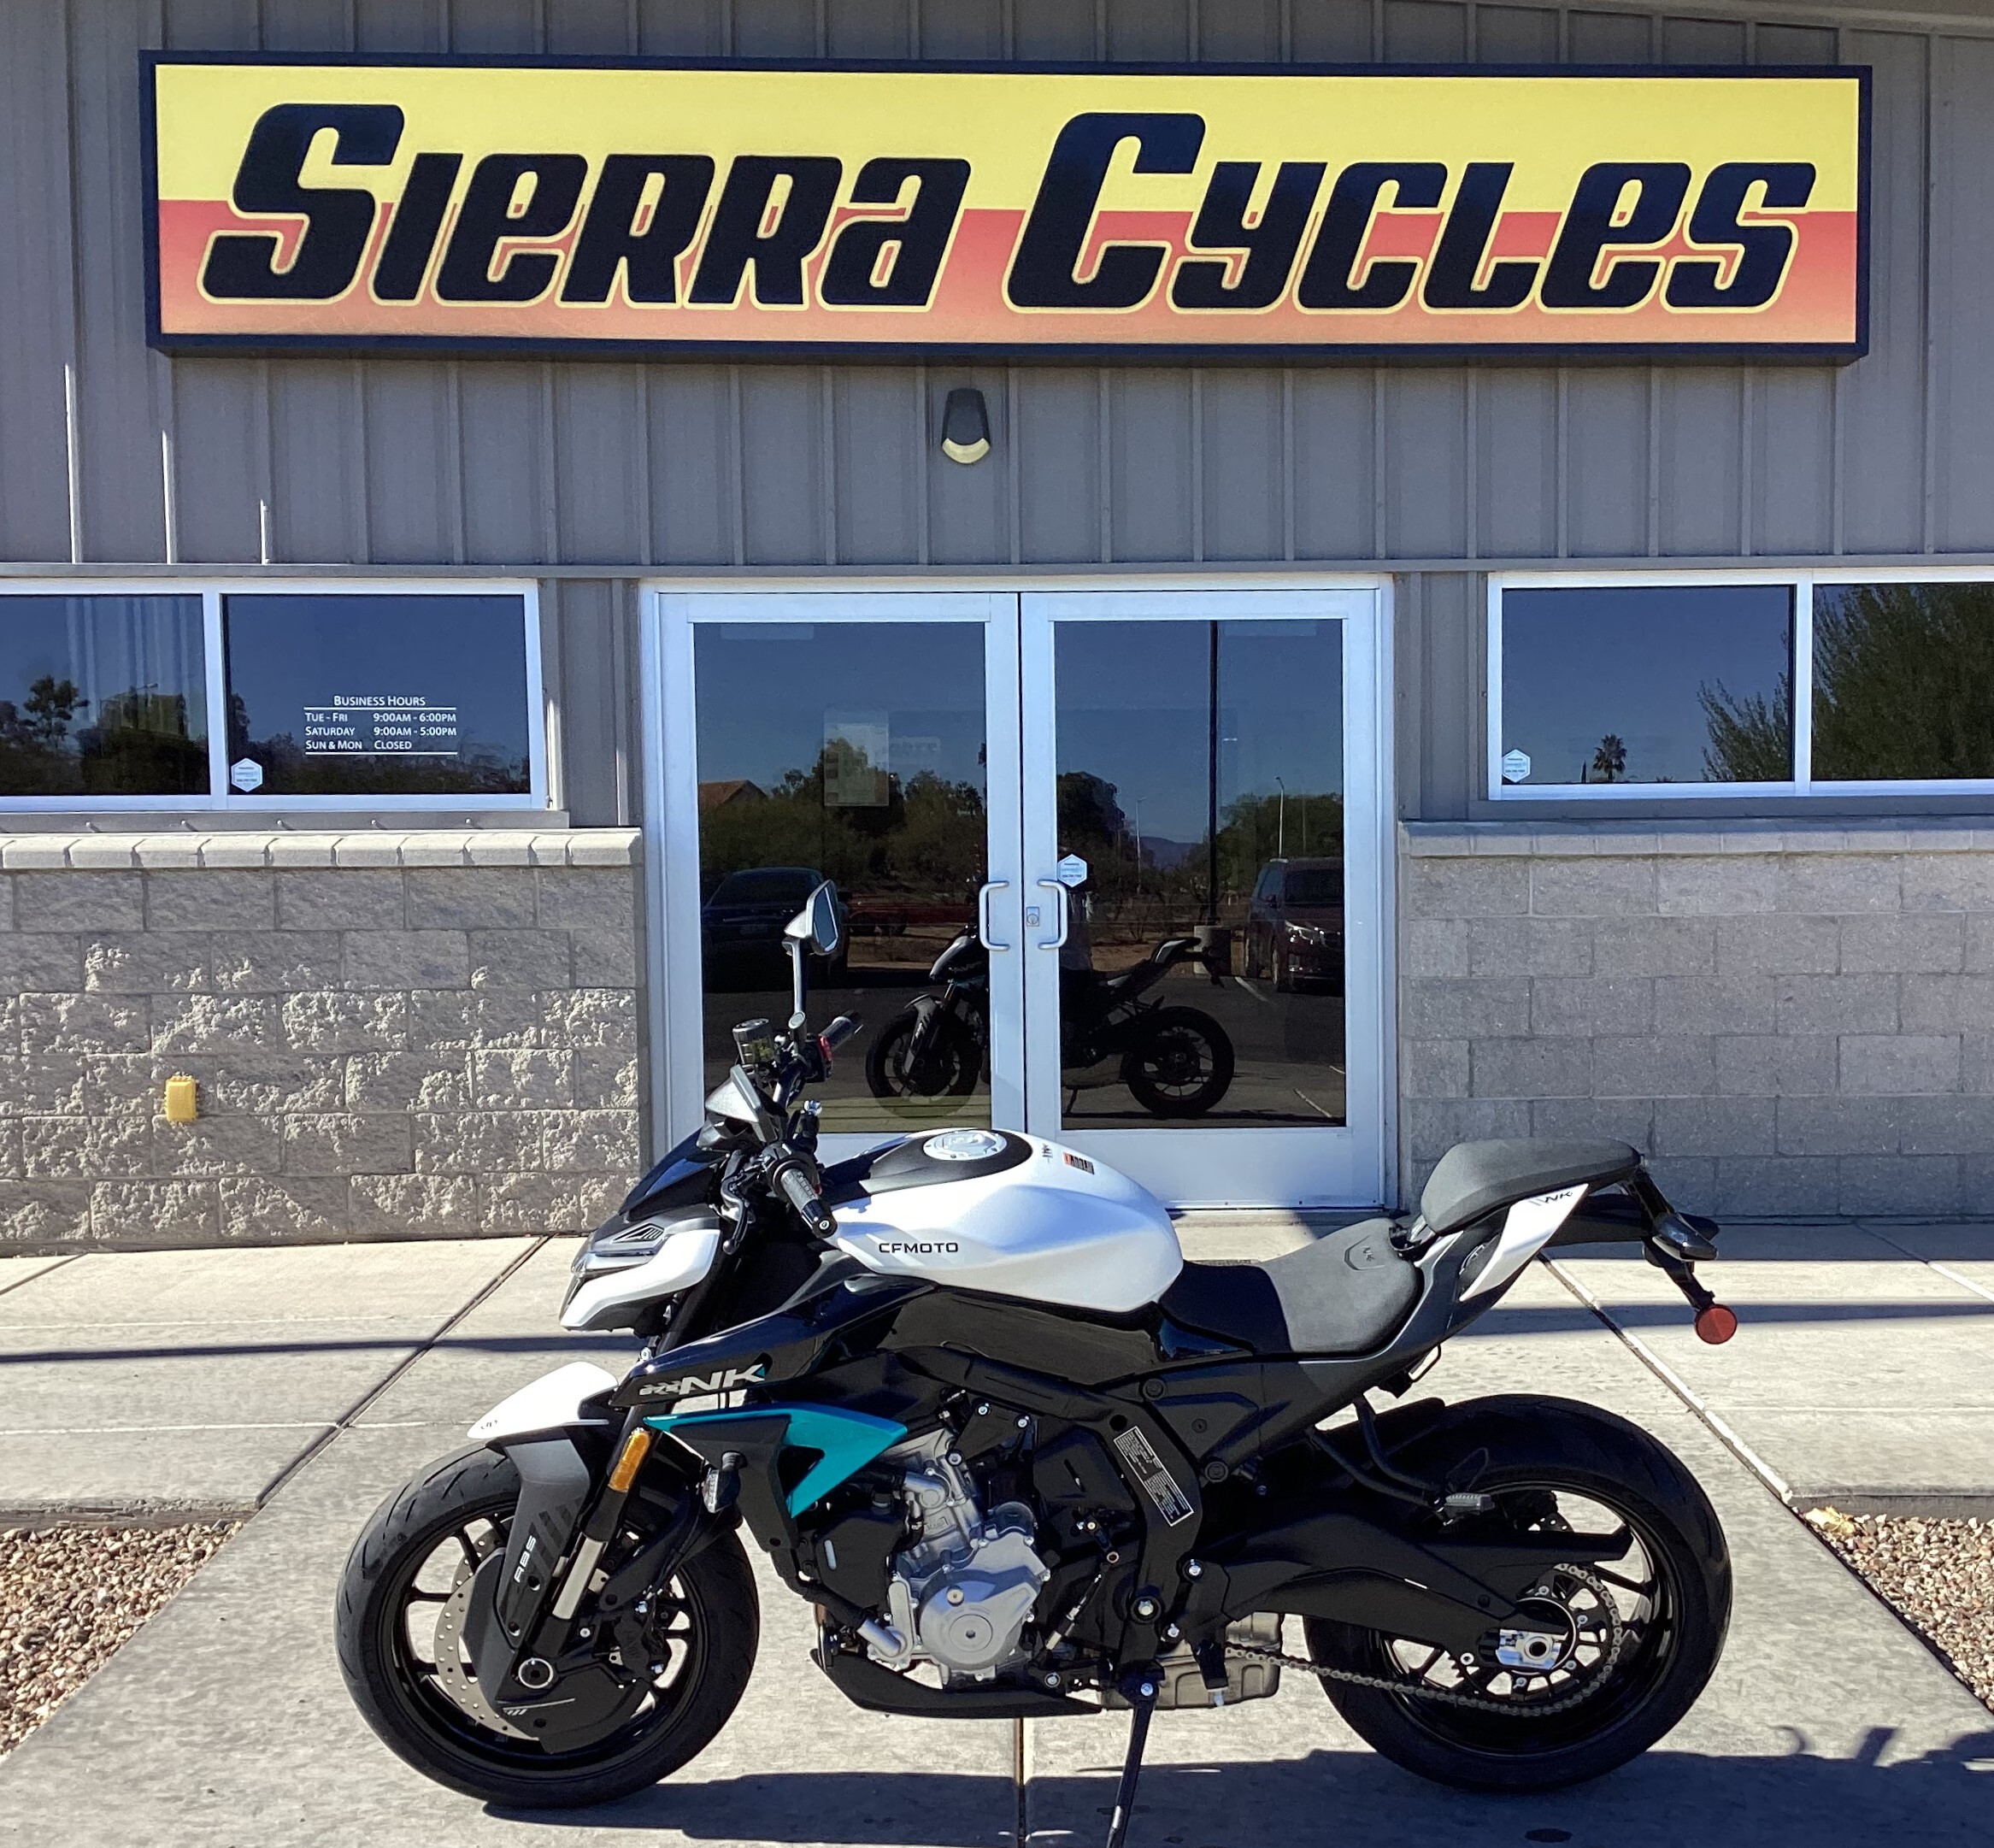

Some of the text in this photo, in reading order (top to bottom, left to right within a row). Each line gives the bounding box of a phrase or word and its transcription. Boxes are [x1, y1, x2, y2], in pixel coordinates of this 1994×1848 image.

[333, 696, 426, 706] BUSINESS HOURS
[305, 713, 324, 722] TUE
[332, 713, 348, 722] FRI
[373, 713, 411, 722] 9:00AM
[419, 713, 456, 722] 6:00PM
[305, 727, 355, 736] SATURDAY
[374, 727, 411, 736] 9:00AM
[420, 727, 456, 736] 5:00PM
[305, 740, 412, 750] SUN & MON CLOSED
[879, 1242, 958, 1253] CFMOTO
[514, 1535, 536, 1583] ABS
